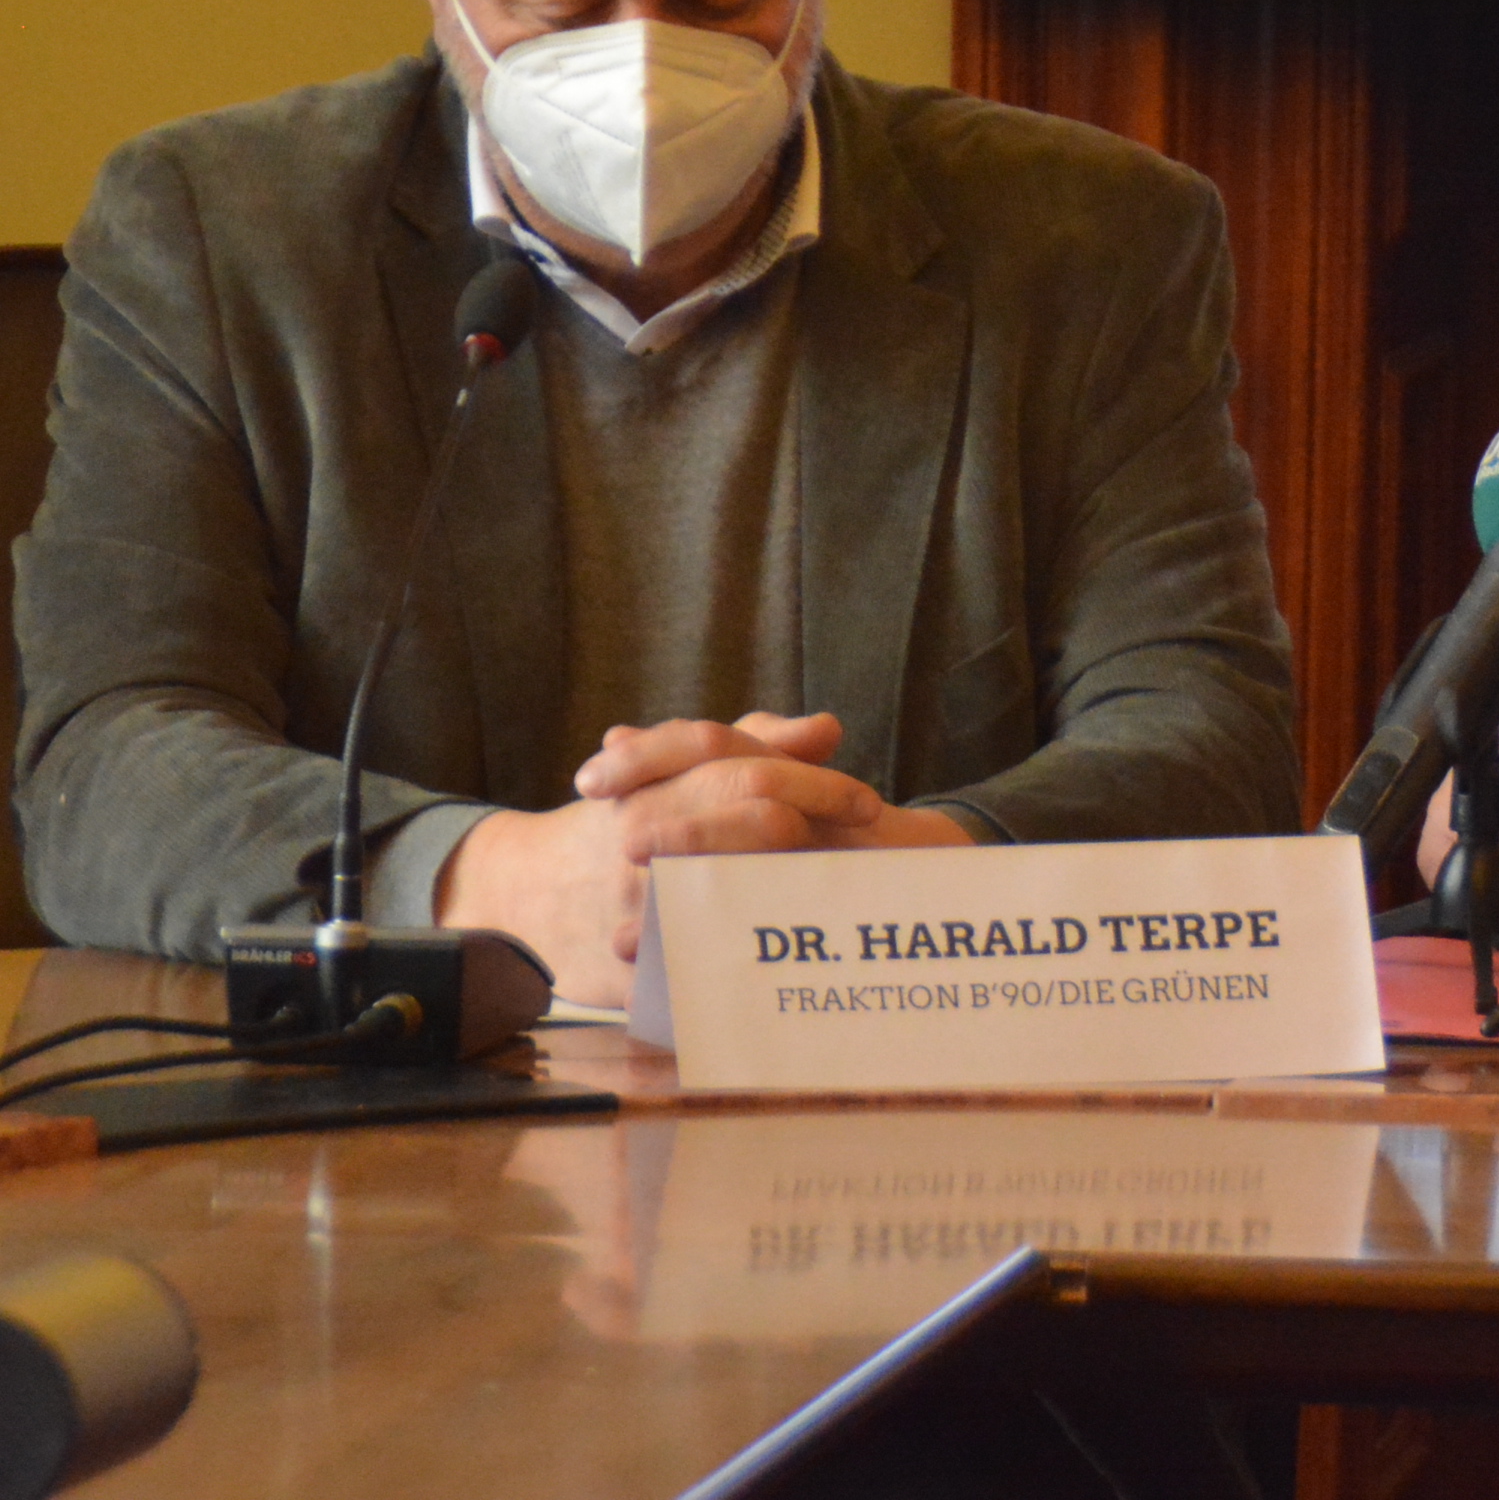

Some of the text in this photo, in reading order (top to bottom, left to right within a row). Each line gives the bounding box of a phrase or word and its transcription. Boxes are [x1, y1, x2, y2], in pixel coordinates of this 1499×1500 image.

[753, 909, 1280, 963] DR. HARALD TERPE
[777, 984, 960, 1012] FRAKTION
[1122, 969, 1270, 1004] GRÜNEN
